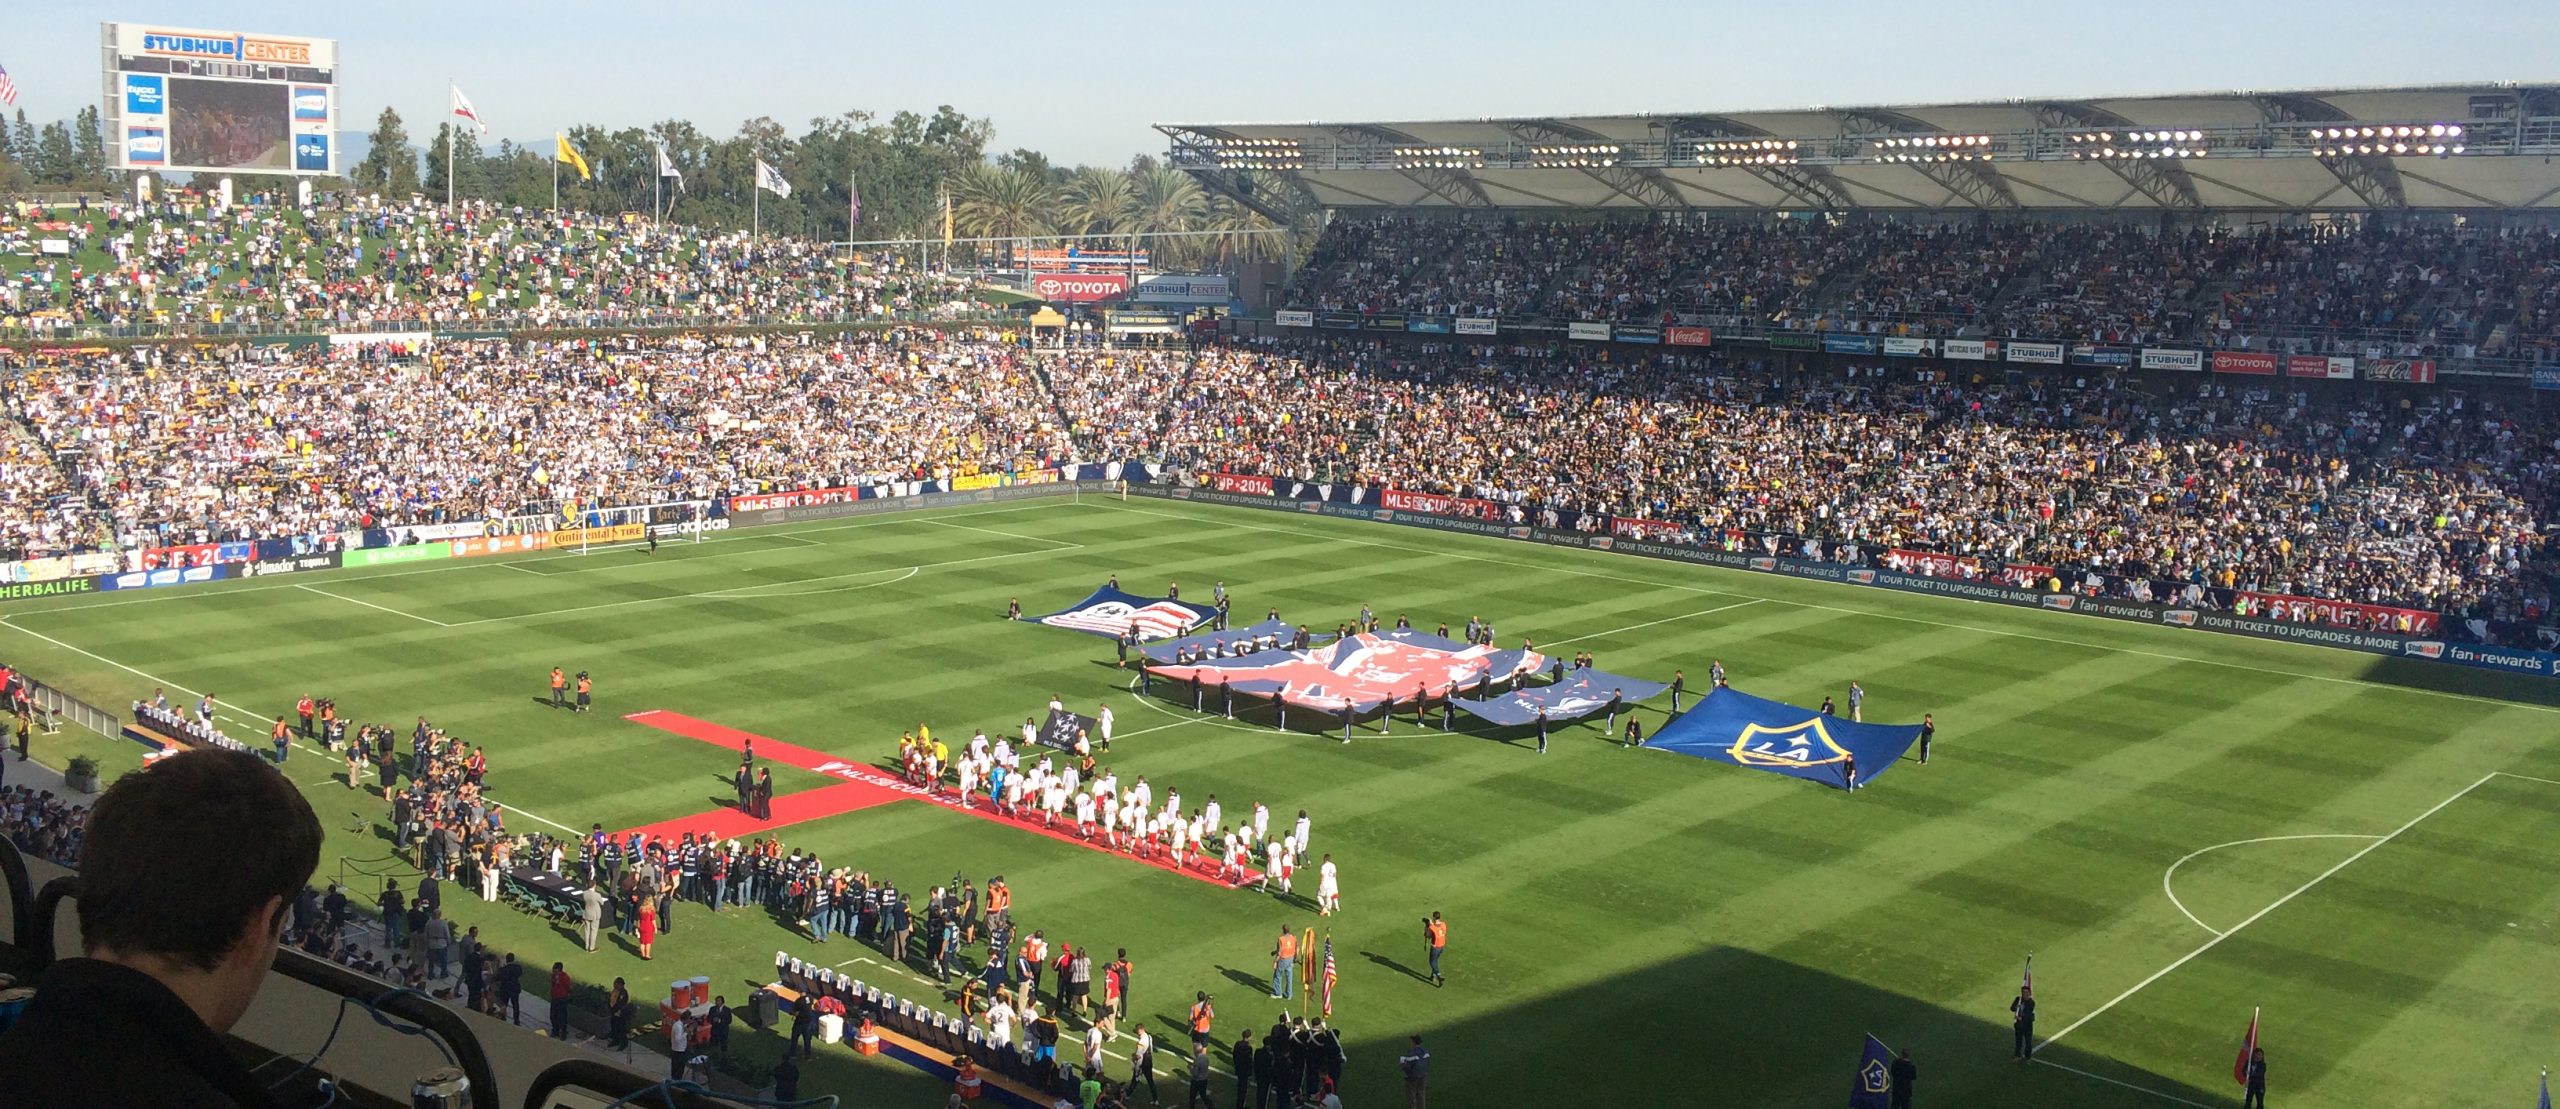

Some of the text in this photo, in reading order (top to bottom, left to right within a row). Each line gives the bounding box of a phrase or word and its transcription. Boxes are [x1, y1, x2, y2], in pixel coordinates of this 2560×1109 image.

[244, 43, 309, 61] CENTER
[1062, 281, 1121, 294] TOYOTA
[1191, 286, 1226, 296] CENTER
[1458, 320, 1495, 331] STUBHUB!
[1772, 334, 1818, 347] HERBALIFE
[2010, 346, 2060, 358] STUBHUB!
[2144, 353, 2199, 365] STUBHUB!
[2233, 358, 2273, 369] TOYOTA
[1139, 486, 1167, 496] rewards
[1241, 476, 1269, 494] 2014
[1193, 491, 1209, 500] YOUR
[1231, 494, 1239, 502] TO
[1239, 496, 1272, 506] UPGRADES
[1278, 500, 1298, 508] MORE
[1386, 493, 1411, 508] MLS
[831, 505, 841, 514] TO
[1323, 504, 1368, 517] fan rewards
[677, 517, 730, 534] adidas
[1395, 512, 1412, 522] YOUR
[1413, 515, 1435, 525] TICKET
[1435, 518, 1444, 526] TO
[1444, 519, 1480, 532] UPGRADES
[1480, 524, 1486, 532] &
[1486, 525, 1507, 534] MORE
[554, 526, 641, 545] Continental TIRE
[1533, 530, 1547, 539] fan
[1549, 533, 1584, 545] rewards
[1616, 541, 1636, 551] YOUR
[1637, 543, 1662, 554] TICKET
[1662, 546, 1674, 556] TO
[1674, 548, 1715, 562] UPGRADES
[1715, 553, 1722, 562] &
[1723, 555, 1746, 566] MORE
[258, 559, 296, 576] Jimador
[300, 556, 330, 568] TEQUILA
[1780, 560, 1840, 579] fan rewards
[0, 579, 90, 599] HERBALIFE
[1879, 574, 2038, 603] YOUR TICKET TO UPGRADES & MORE
[2080, 599, 2154, 619] fan rewards
[2202, 615, 2399, 650] YOUR TICKET TO UPGRADES & MORE
[2408, 643, 2440, 655] StubHub!
[2450, 646, 2473, 661] fan
[2481, 653, 2543, 670] rewards
[1752, 741, 1809, 761] LA
[836, 767, 873, 782] MLS
[998, 1012, 1004, 1023] 2
